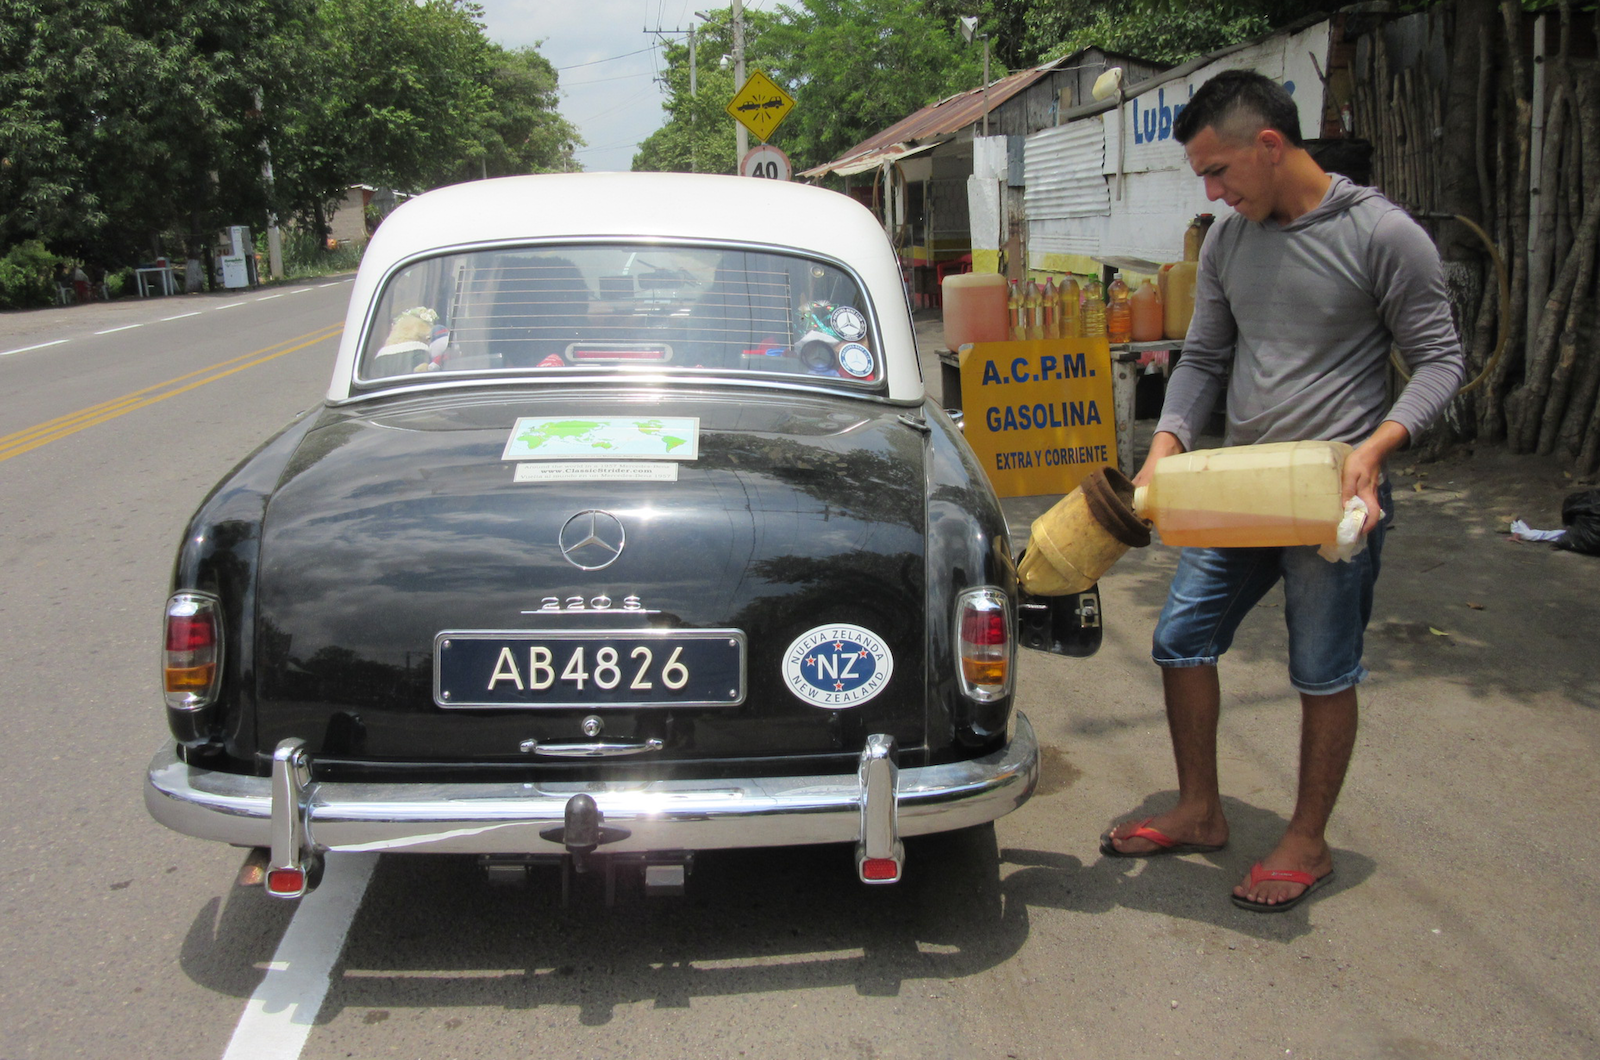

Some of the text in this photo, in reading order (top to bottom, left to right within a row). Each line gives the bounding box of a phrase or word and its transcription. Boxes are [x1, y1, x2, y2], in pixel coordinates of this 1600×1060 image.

[752, 161, 779, 180] 40
[982, 353, 1096, 386] A.C.P.M.
[986, 400, 1102, 432] GASOLINA
[996, 445, 1108, 470] EXTRA Y CORRIENTE
[541, 595, 612, 611] 220
[791, 630, 884, 664] NUEVA ZELANDA
[487, 646, 690, 691] AB4826
[817, 652, 860, 680] NZ
[792, 671, 885, 703] NEW ZEALAND
